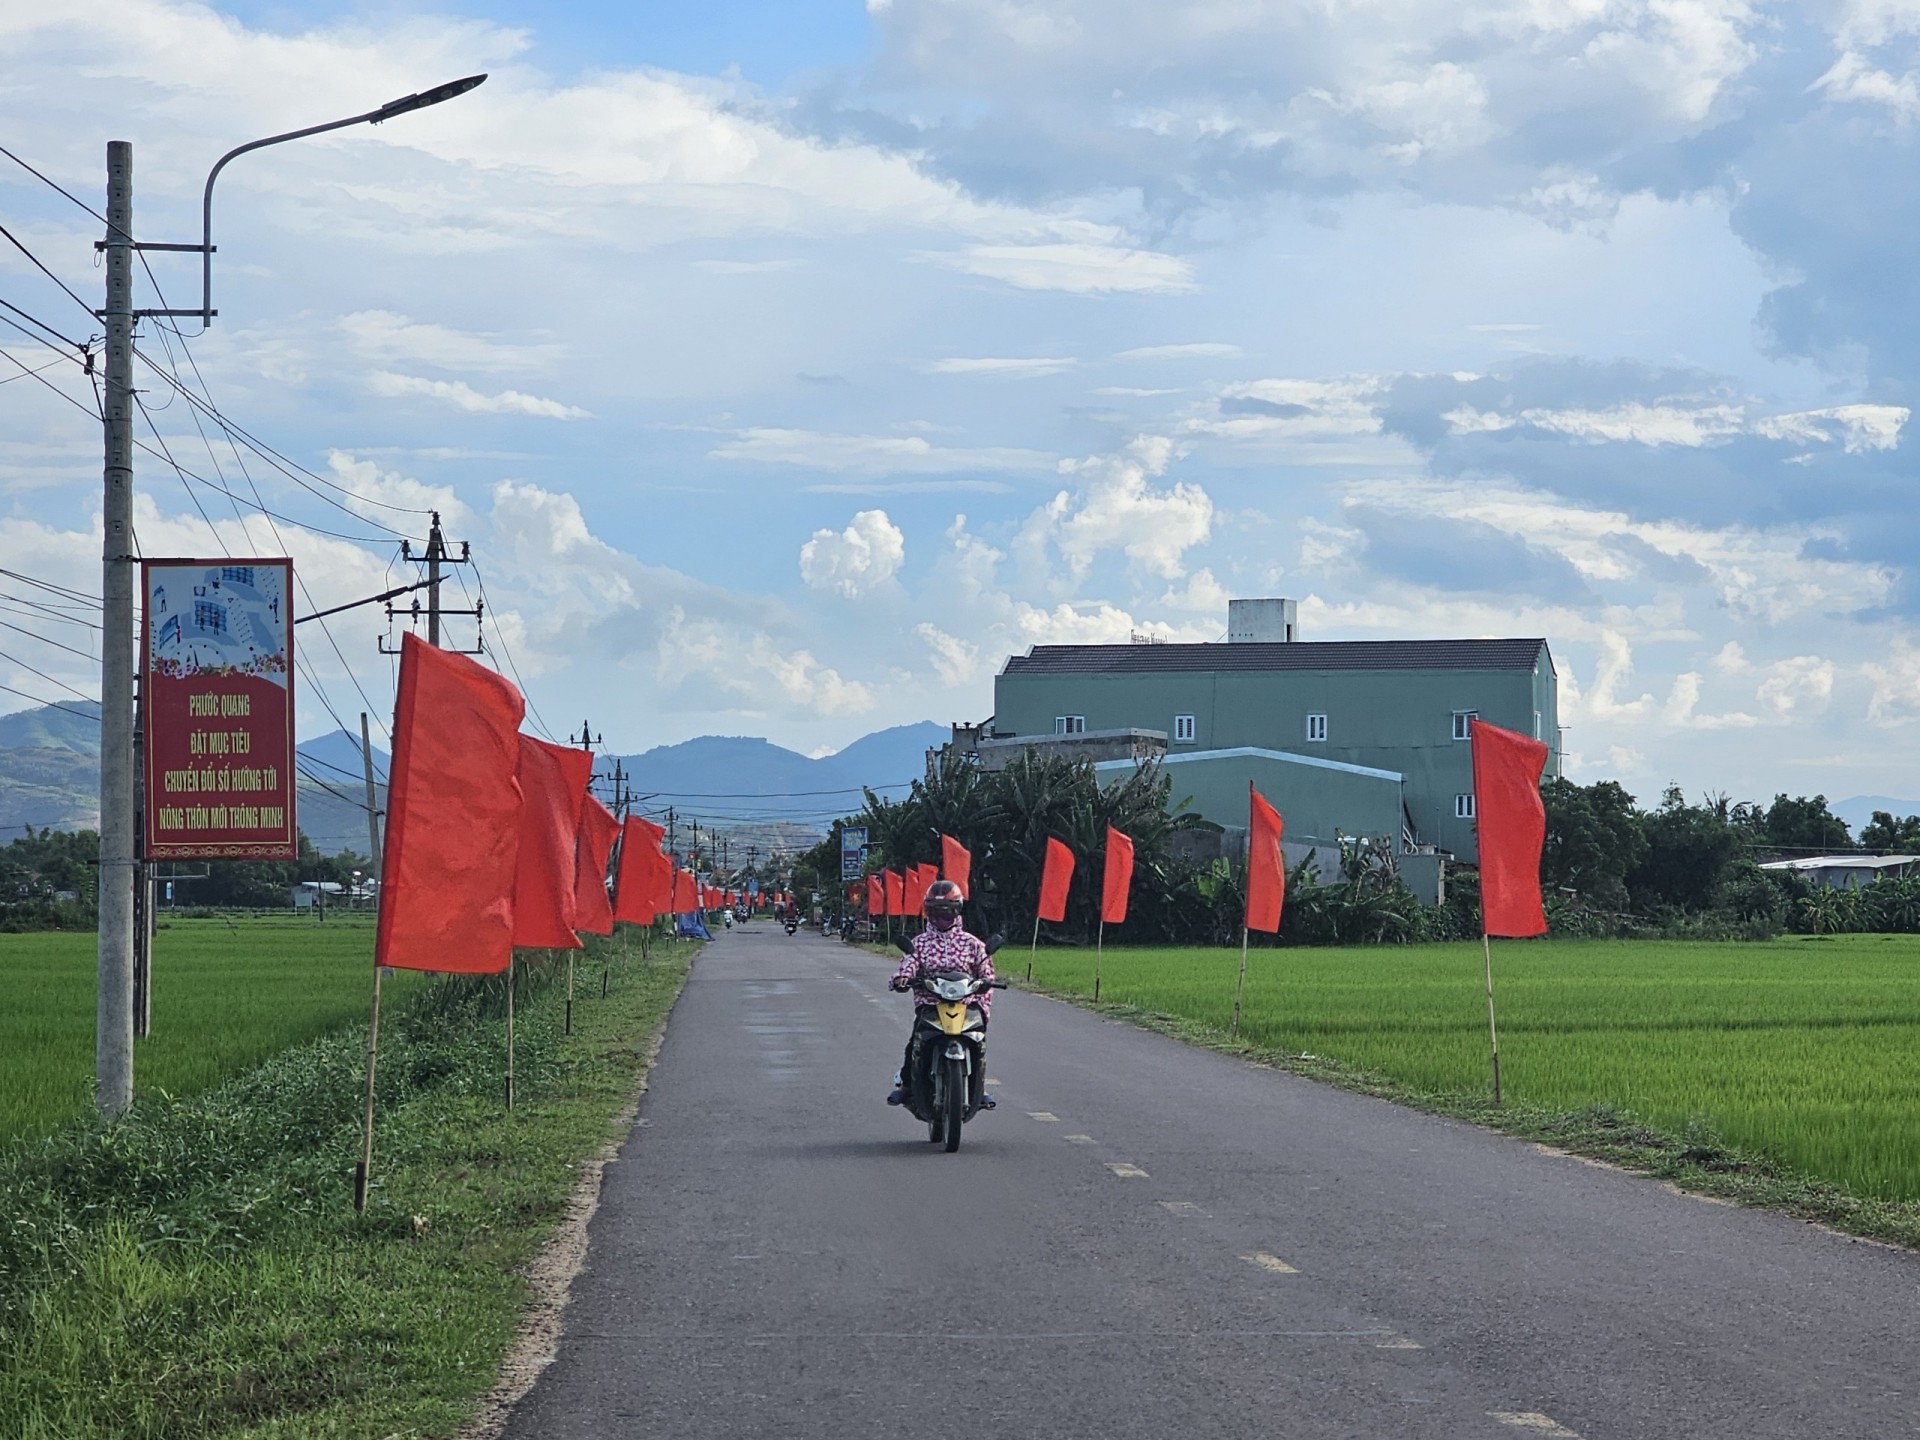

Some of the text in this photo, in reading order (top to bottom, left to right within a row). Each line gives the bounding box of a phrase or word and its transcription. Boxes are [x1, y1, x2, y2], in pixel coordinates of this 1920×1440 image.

[190, 690, 250, 719] PHƯỚC QUANG
[191, 727, 250, 759] ĐẶT MỤC TIÊU
[165, 761, 277, 792] CHUYỂN ĐỔI SỐ HƯỚNG TỚI
[159, 803, 283, 829] NÔNG THÔN MỚI THÔNG MINH
